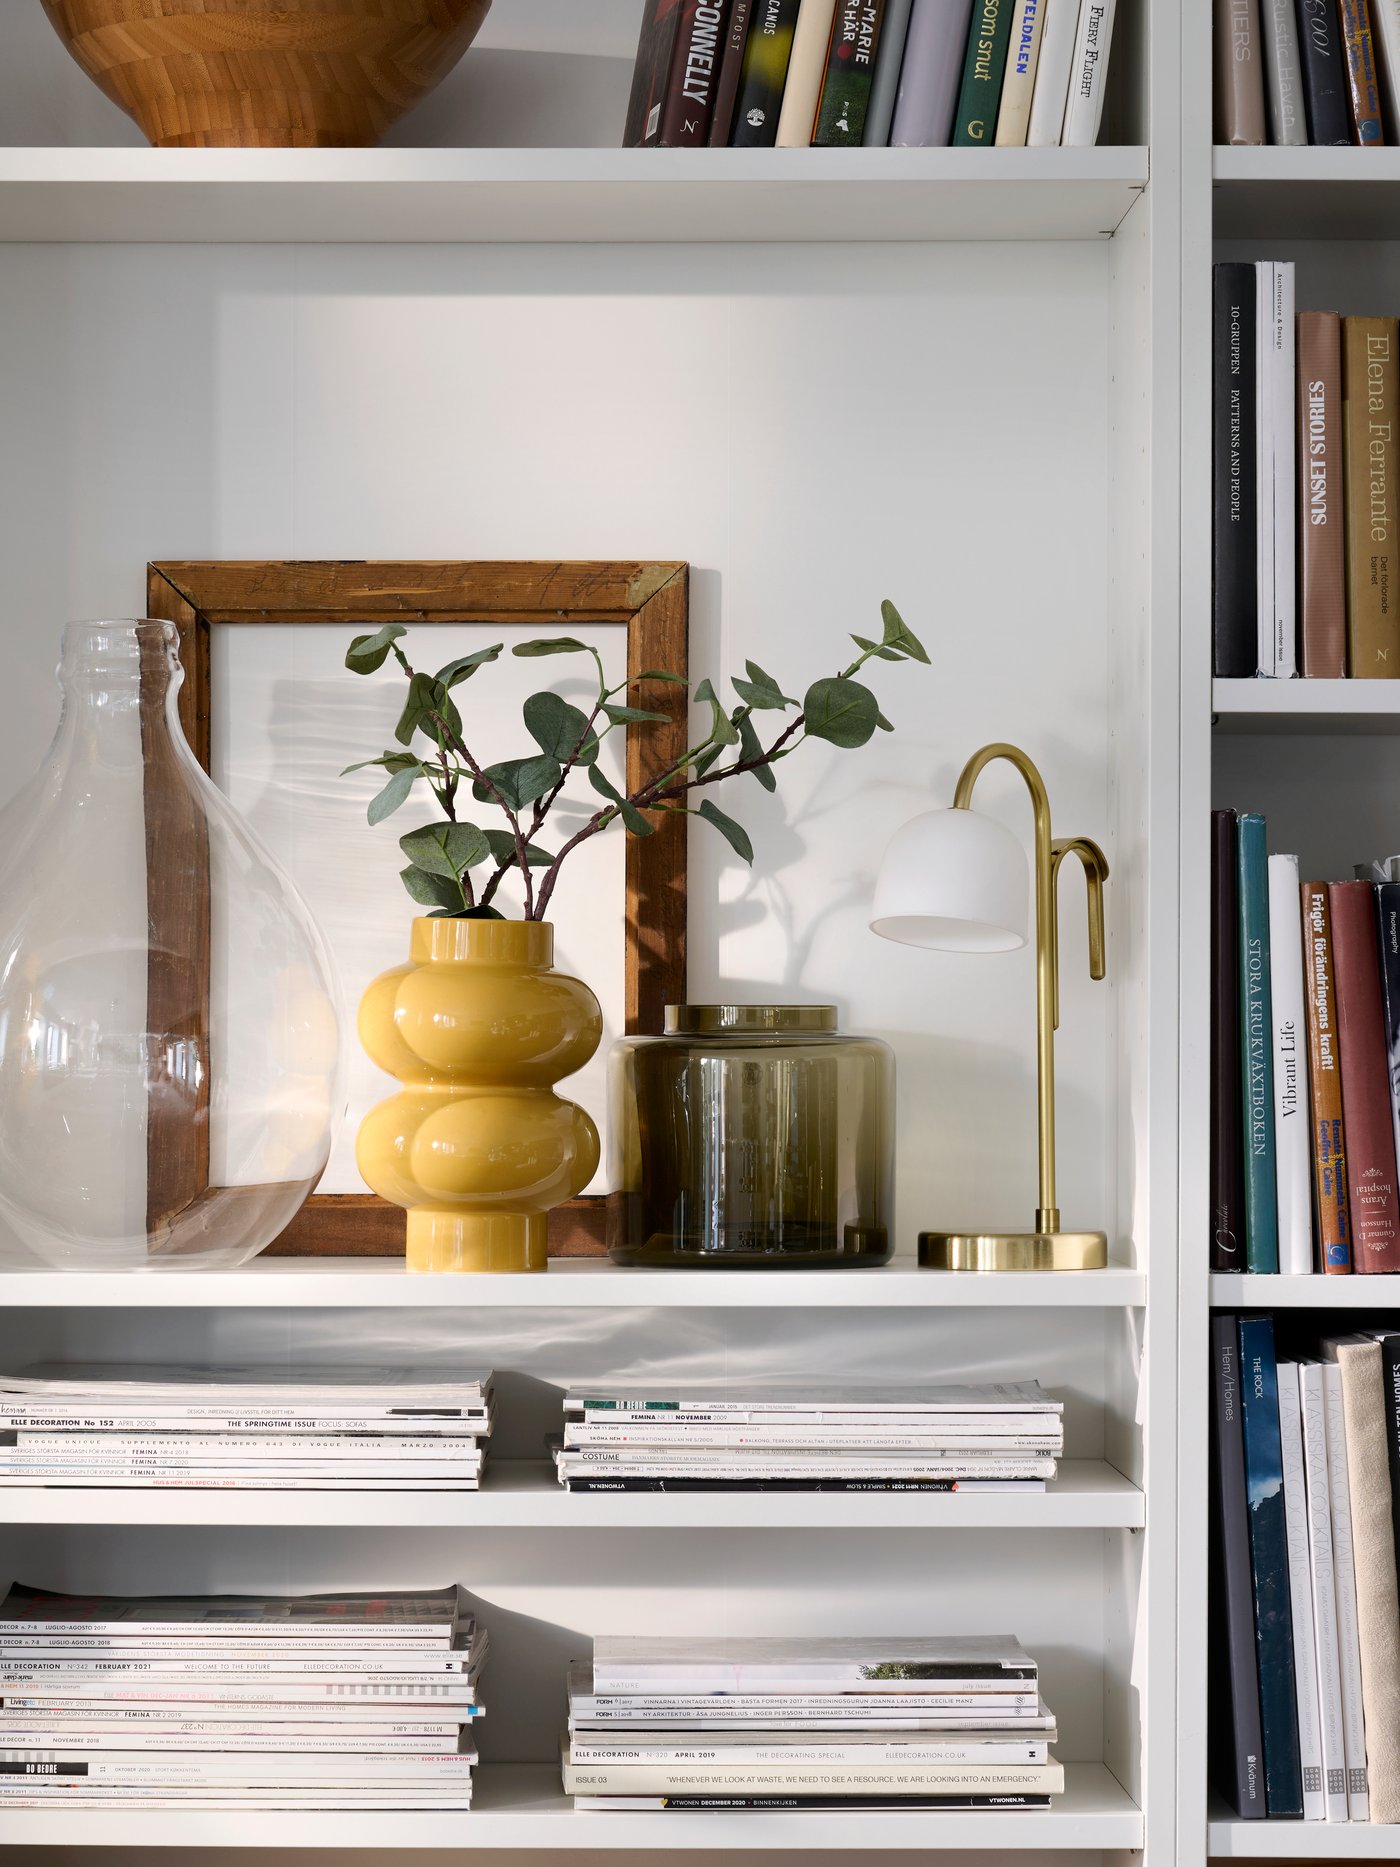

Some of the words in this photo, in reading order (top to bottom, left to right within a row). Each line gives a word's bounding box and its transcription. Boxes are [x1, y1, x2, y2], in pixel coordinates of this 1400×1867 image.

[843, 10, 860, 41] HÄR
[980, 0, 999, 37] som
[1087, 5, 1105, 46] FIERY
[974, 39, 993, 81] snut
[1081, 49, 1099, 98] FLIGHT
[1279, 67, 1296, 128] Haven
[1230, 305, 1241, 375] 10-GRUPPEN
[1367, 333, 1390, 415] Elena
[1230, 390, 1241, 449] PATTERNS
[1309, 380, 1326, 455] STORIES
[1231, 450, 1241, 476] AND
[1369, 421, 1392, 542] Ferrante
[1230, 478, 1240, 522] PEOPLE
[1310, 460, 1327, 525] SUNSET
[1370, 556, 1379, 585] barnet
[1380, 556, 1388, 570] Det
[1380, 571, 1389, 615] förlorade
[1310, 893, 1324, 933] Frigör
[1390, 911, 1399, 954] Photography
[1250, 939, 1262, 994] STORA
[1314, 938, 1329, 1030] förändringens
[1280, 1020, 1296, 1053] Life
[1320, 1033, 1335, 1071] kraft!
[1250, 1000, 1266, 1156] KRUKVÄXTBOKEN
[1282, 1059, 1297, 1118] Vibrant
[1320, 1120, 1331, 1164] Geoffrey
[1323, 1167, 1332, 1197] Caine
[1332, 1119, 1342, 1155] Renate
[1337, 1209, 1348, 1238] Caine
[1356, 1184, 1391, 1197] hospital
[1361, 1196, 1388, 1206] Ärans
[1360, 1219, 1392, 1227] Hansson
[1369, 1230, 1395, 1239] Gunnar
[1222, 1346, 1234, 1422] Hem/Homes
[1253, 1357, 1261, 1373] THE
[1253, 1375, 1264, 1399] ROCK
[1305, 1388, 1324, 1476] KLASSISKA
[582, 1453, 620, 1461] COSTUME
[575, 1776, 597, 1784] ISSUE
[597, 1776, 608, 1784] 03
[757, 1776, 785, 1784] WASTE,
[926, 1775, 960, 1783] LOOKING
[1248, 1763, 1257, 1799] Kvänum
